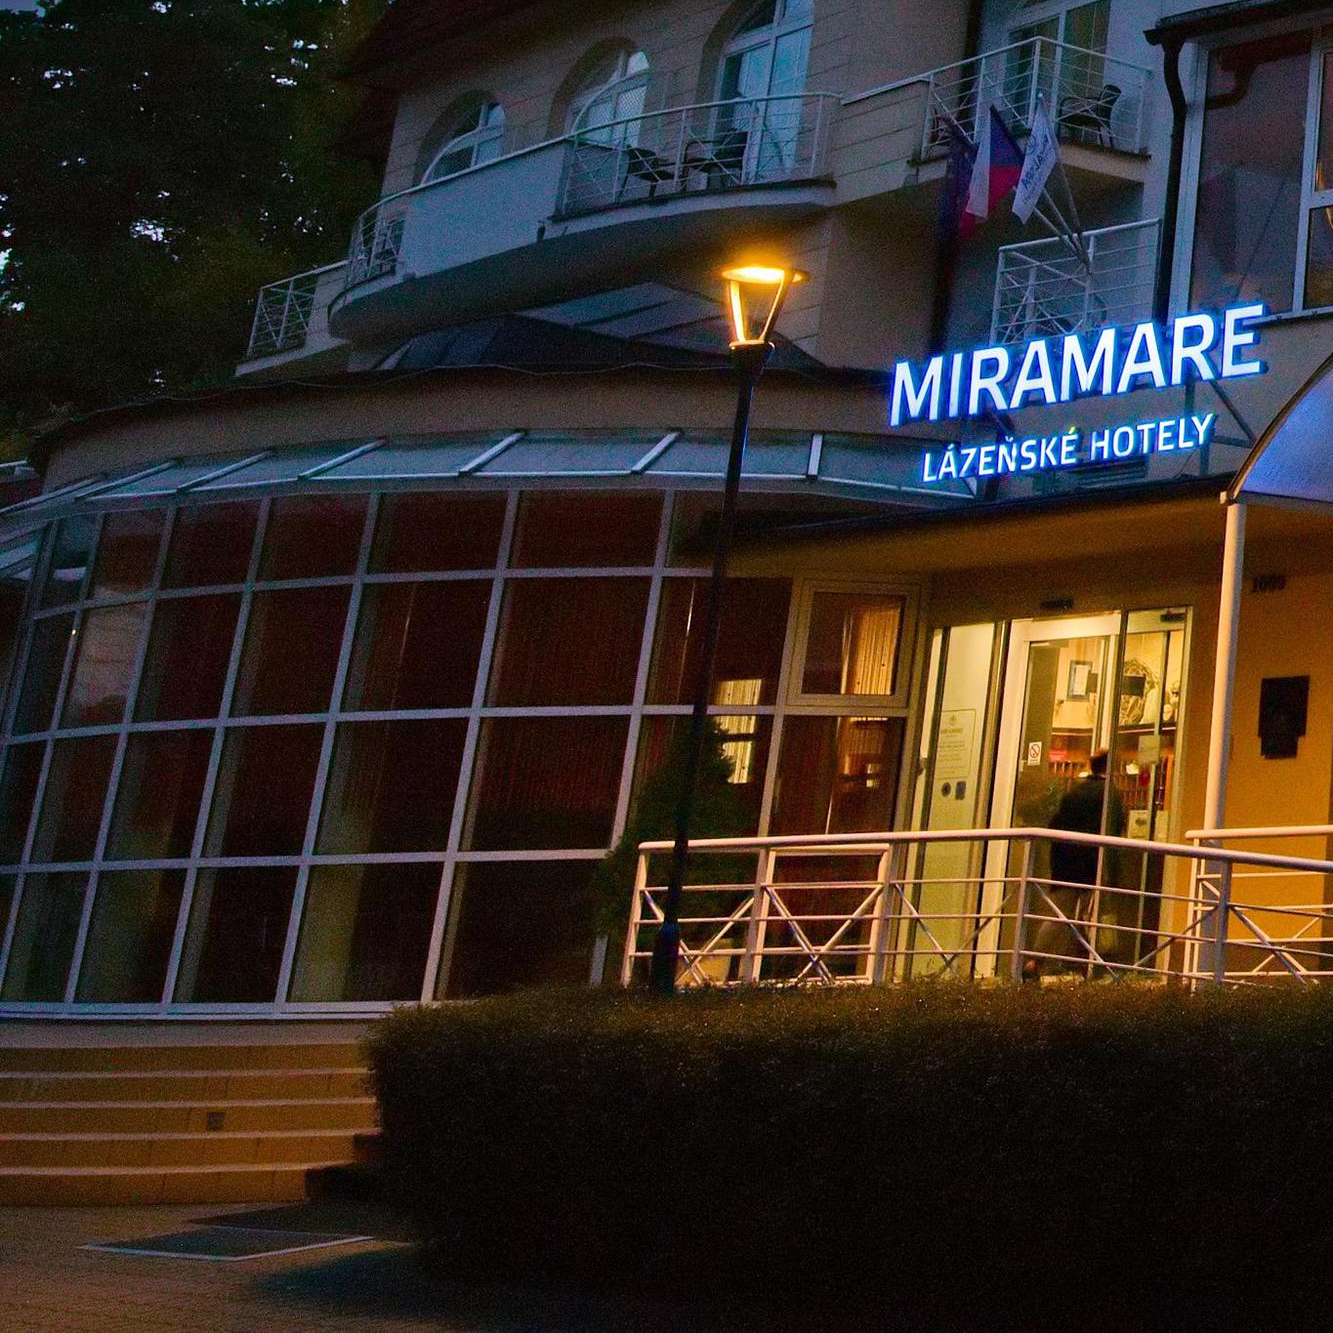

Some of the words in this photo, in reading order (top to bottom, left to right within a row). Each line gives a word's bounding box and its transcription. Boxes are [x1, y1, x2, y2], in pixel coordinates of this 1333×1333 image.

[890, 304, 1264, 426] MIRAMARE
[923, 427, 1079, 482] LÁZEŇSKÉ
[1090, 414, 1213, 460] HOTELY
